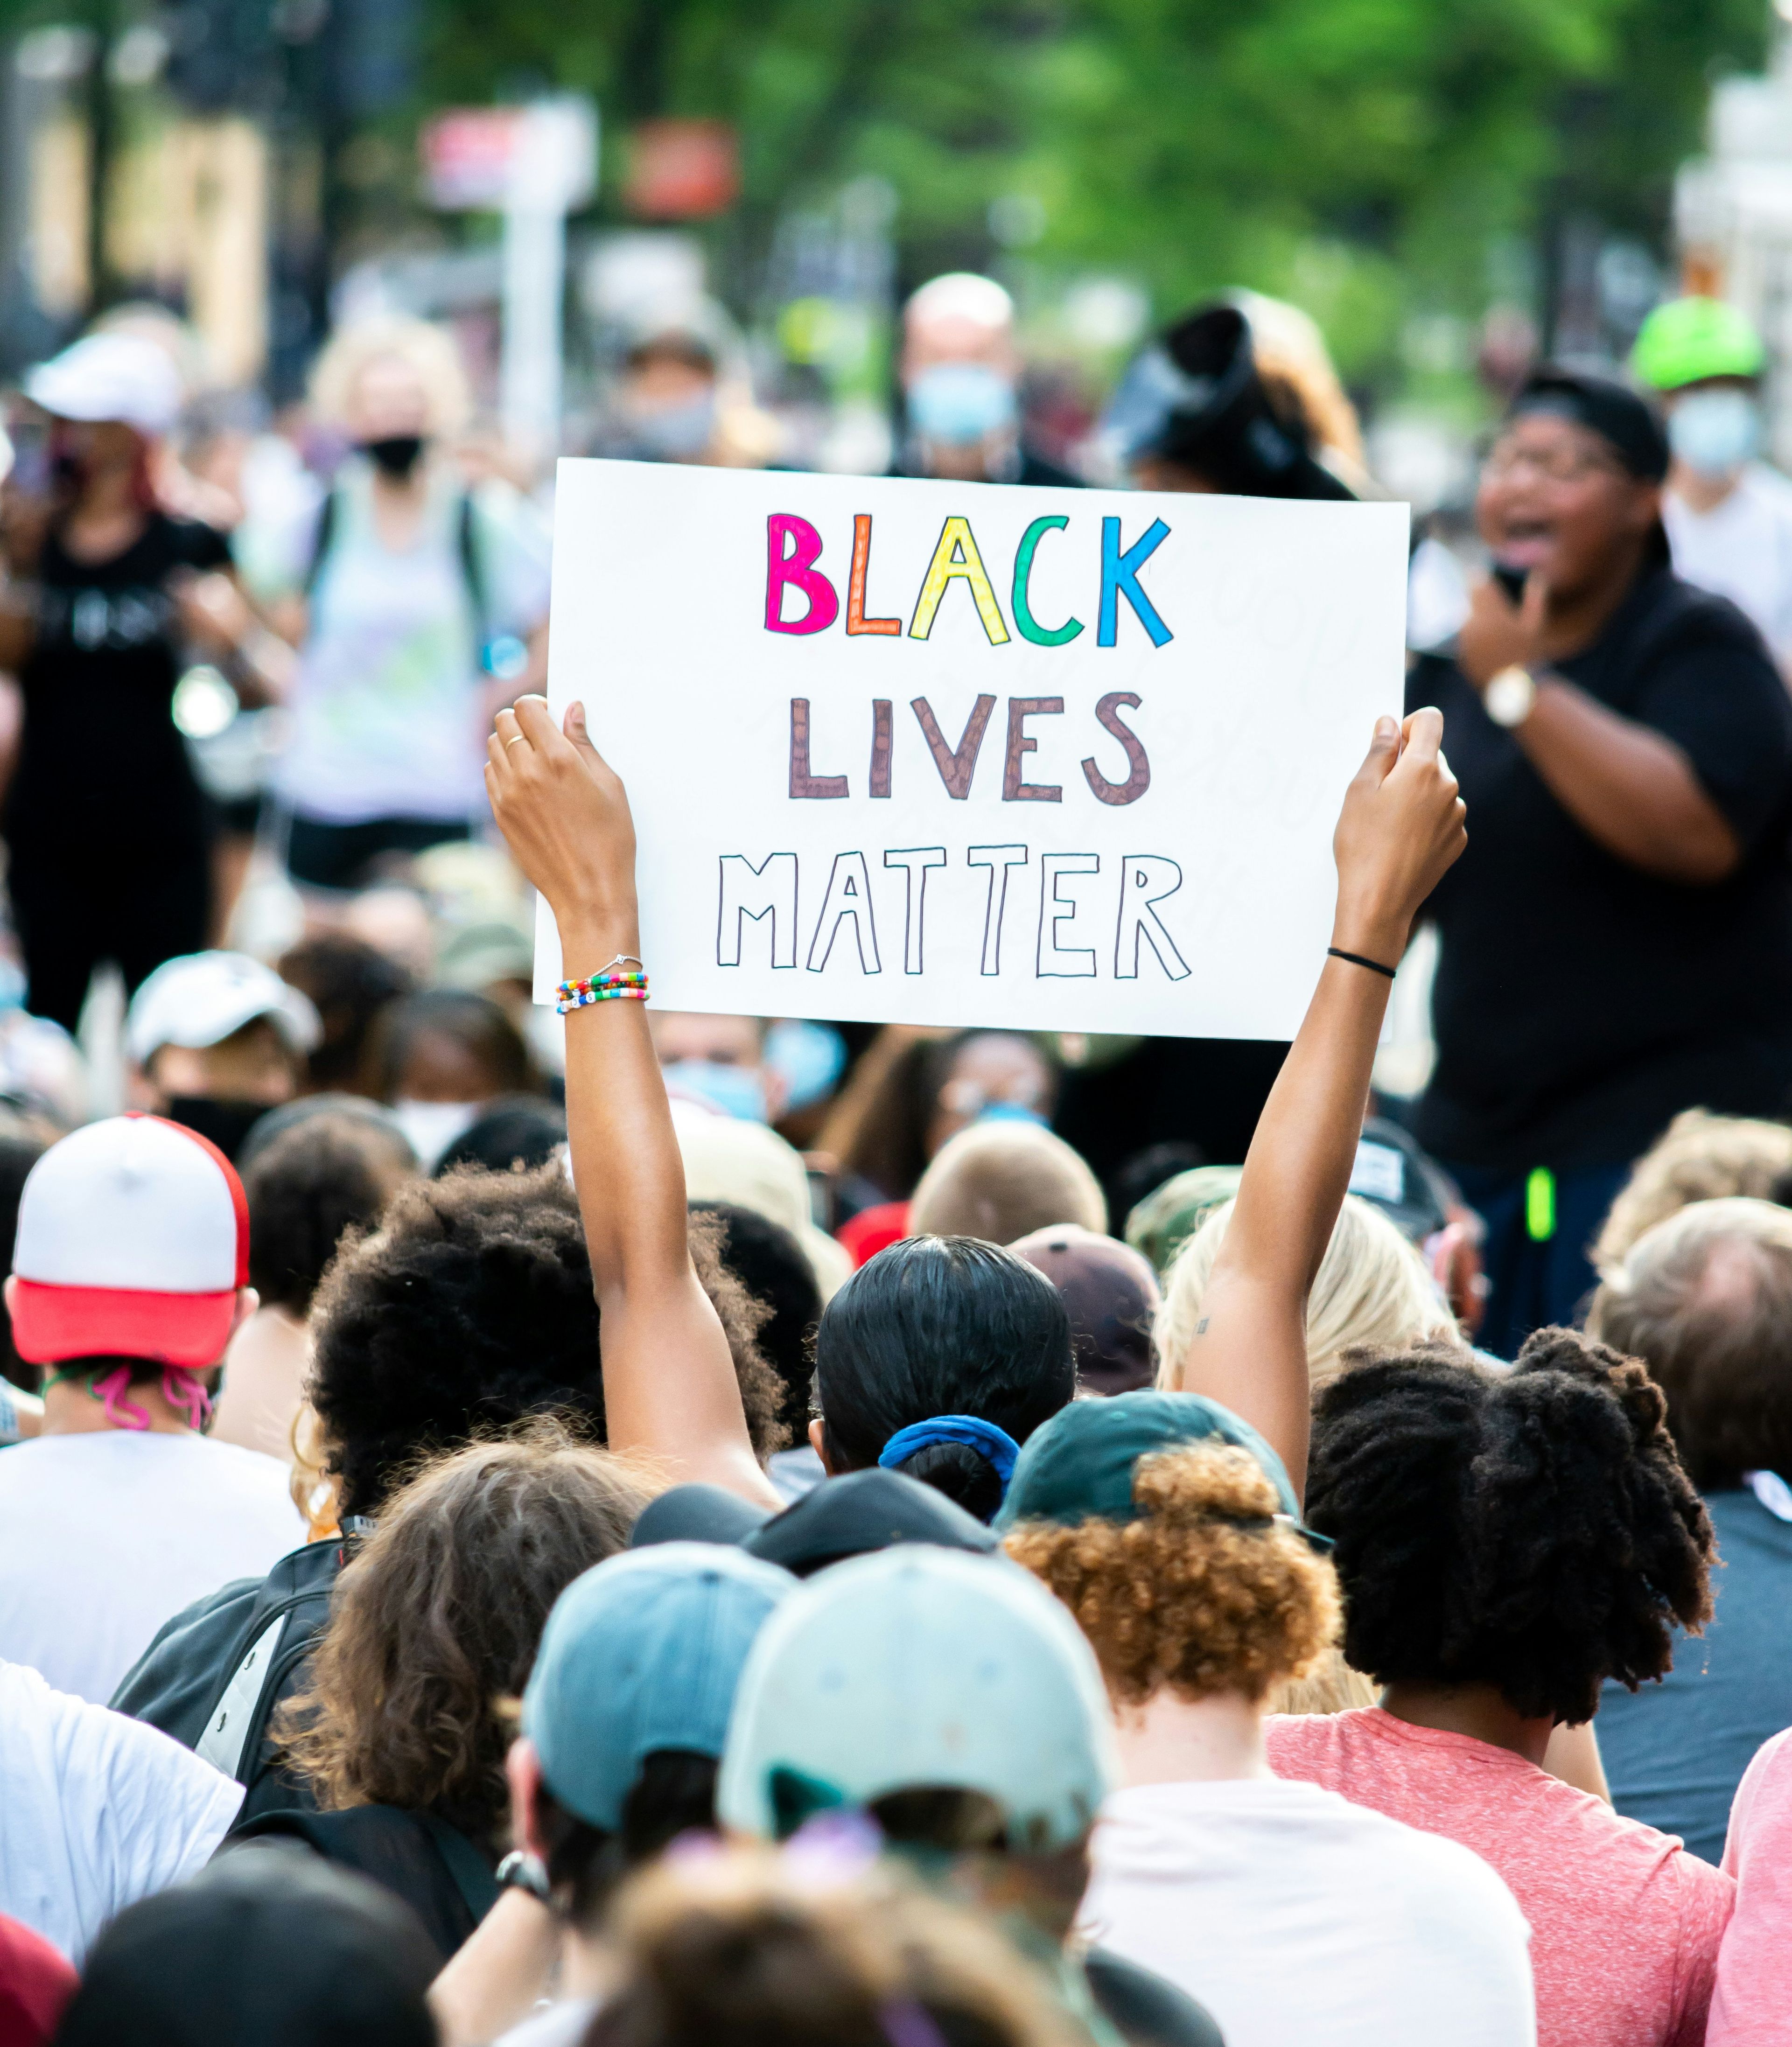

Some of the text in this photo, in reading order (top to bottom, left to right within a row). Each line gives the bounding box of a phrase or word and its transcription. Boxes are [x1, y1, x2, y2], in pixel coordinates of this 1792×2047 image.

[763, 513, 1174, 649] BLACK
[789, 692, 1151, 806] LIVES
[716, 844, 1192, 981] MATTER
